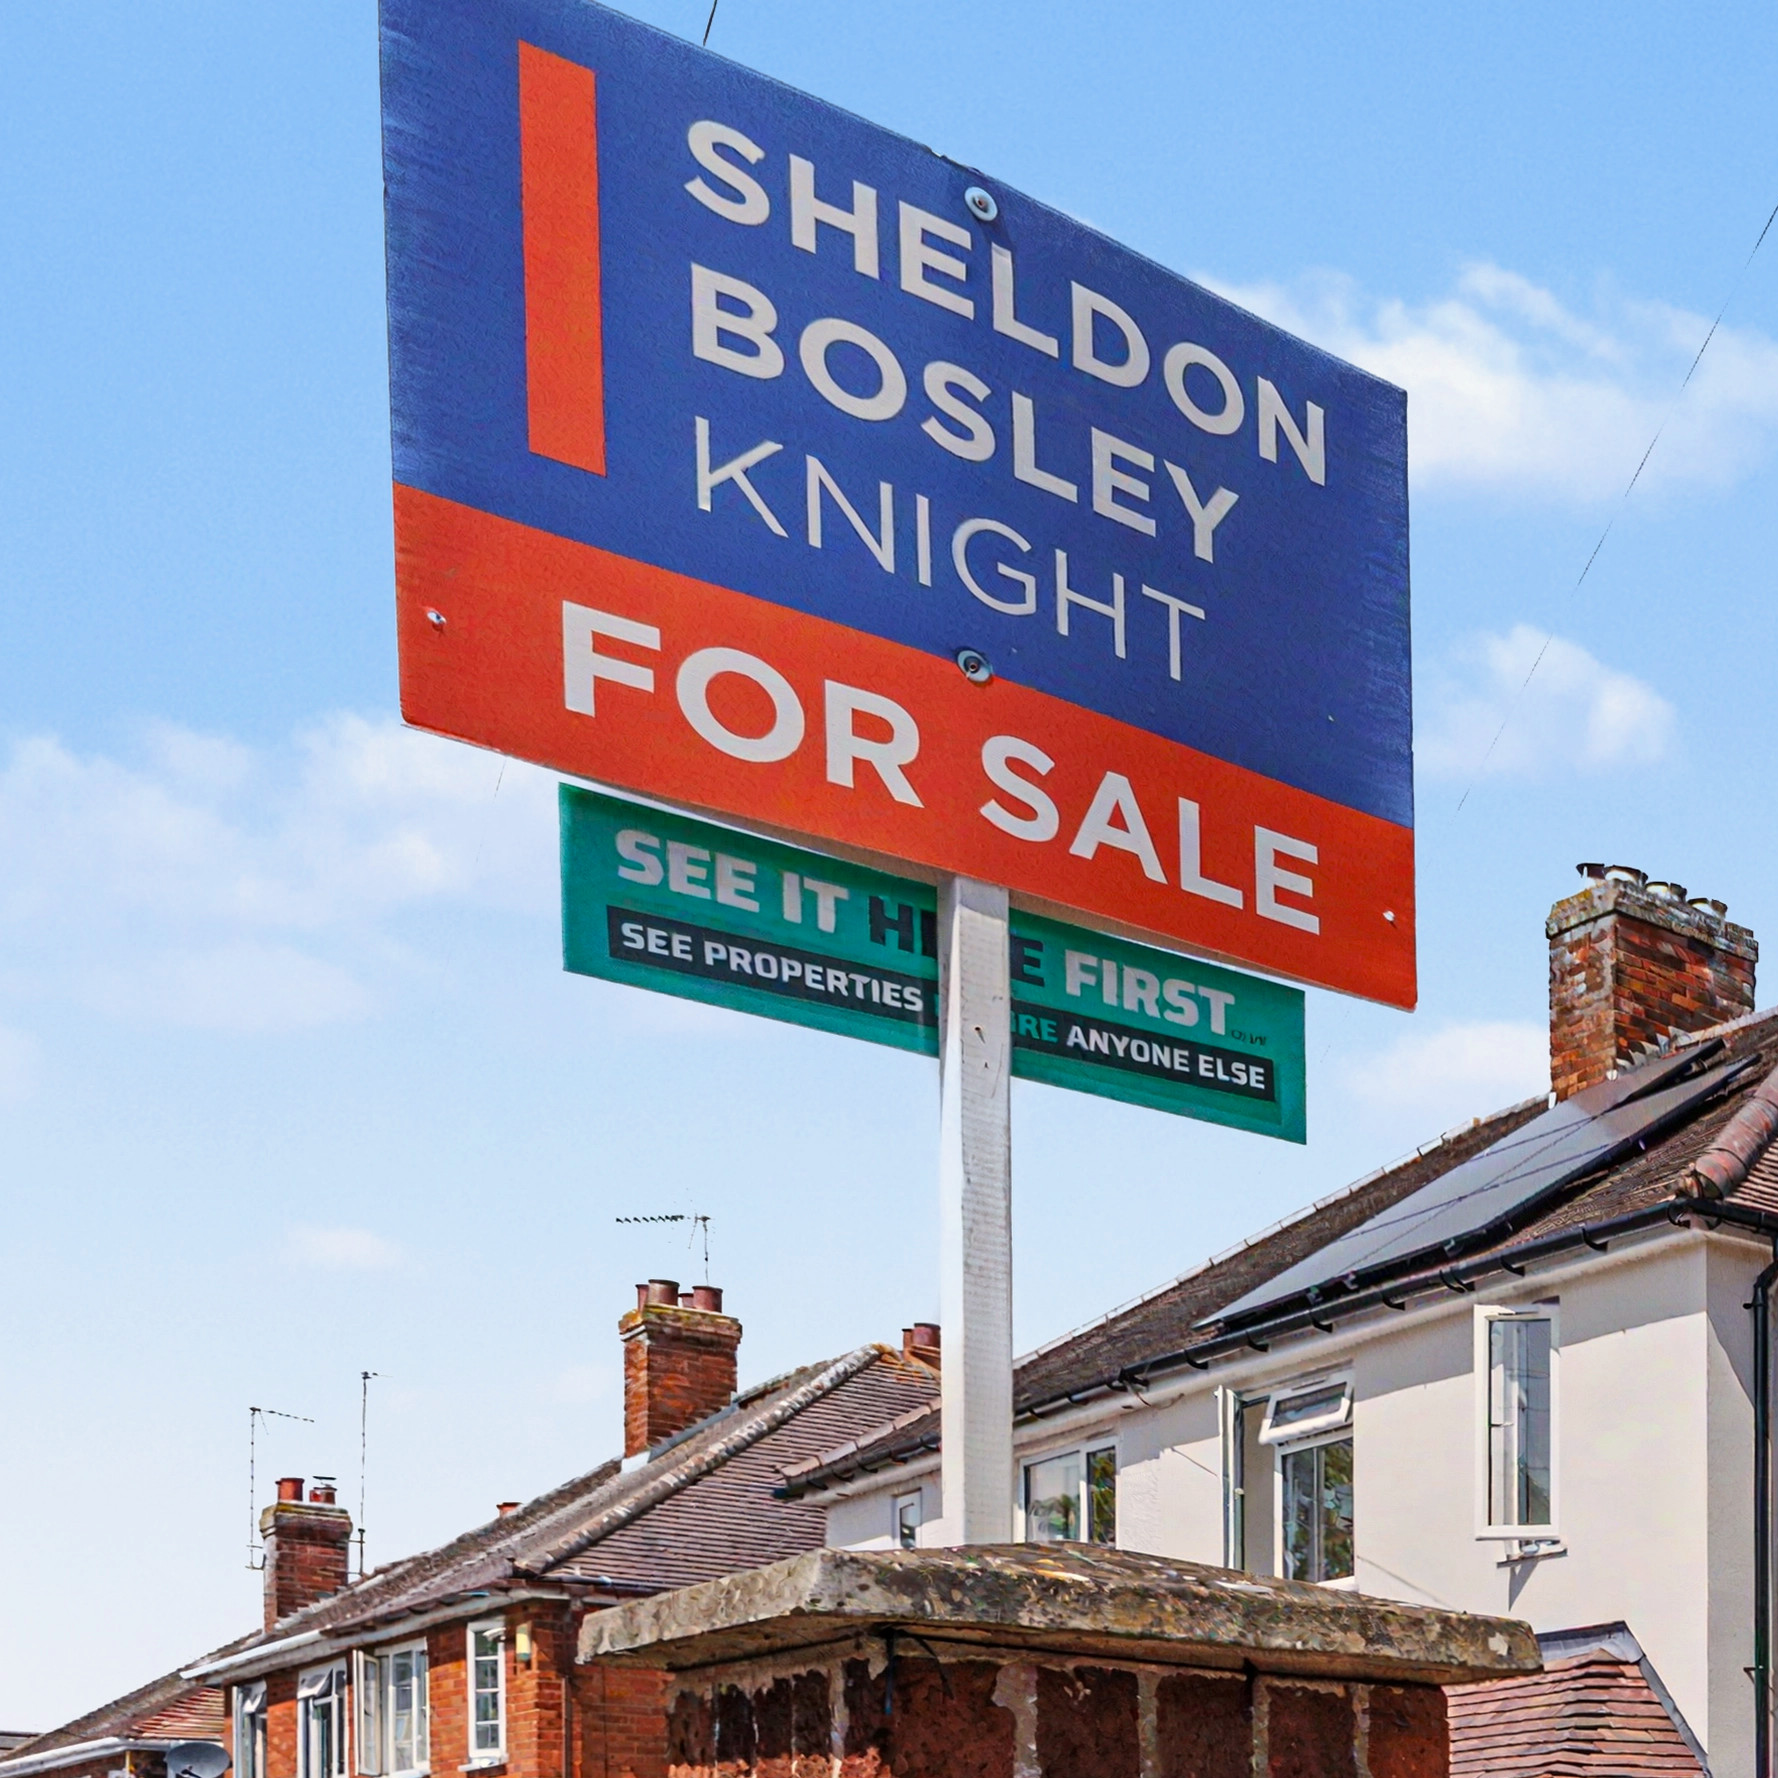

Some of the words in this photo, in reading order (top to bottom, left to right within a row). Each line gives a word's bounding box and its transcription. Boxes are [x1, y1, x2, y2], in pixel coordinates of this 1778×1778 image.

[684, 120, 1325, 486] SHELDON
[691, 262, 1239, 563] BOSLEY
[695, 417, 1205, 681] KNIGHT
[562, 600, 925, 808] FOR
[980, 735, 1320, 935] SALE
[615, 829, 760, 913] SEE
[783, 871, 849, 934] IT
[1065, 949, 1236, 1036] FIRST
[621, 922, 693, 962] SEE
[704, 940, 924, 1013] PROPERTIES
[1066, 1024, 1190, 1073] ANYONE
[1198, 1053, 1266, 1090] ELSE
